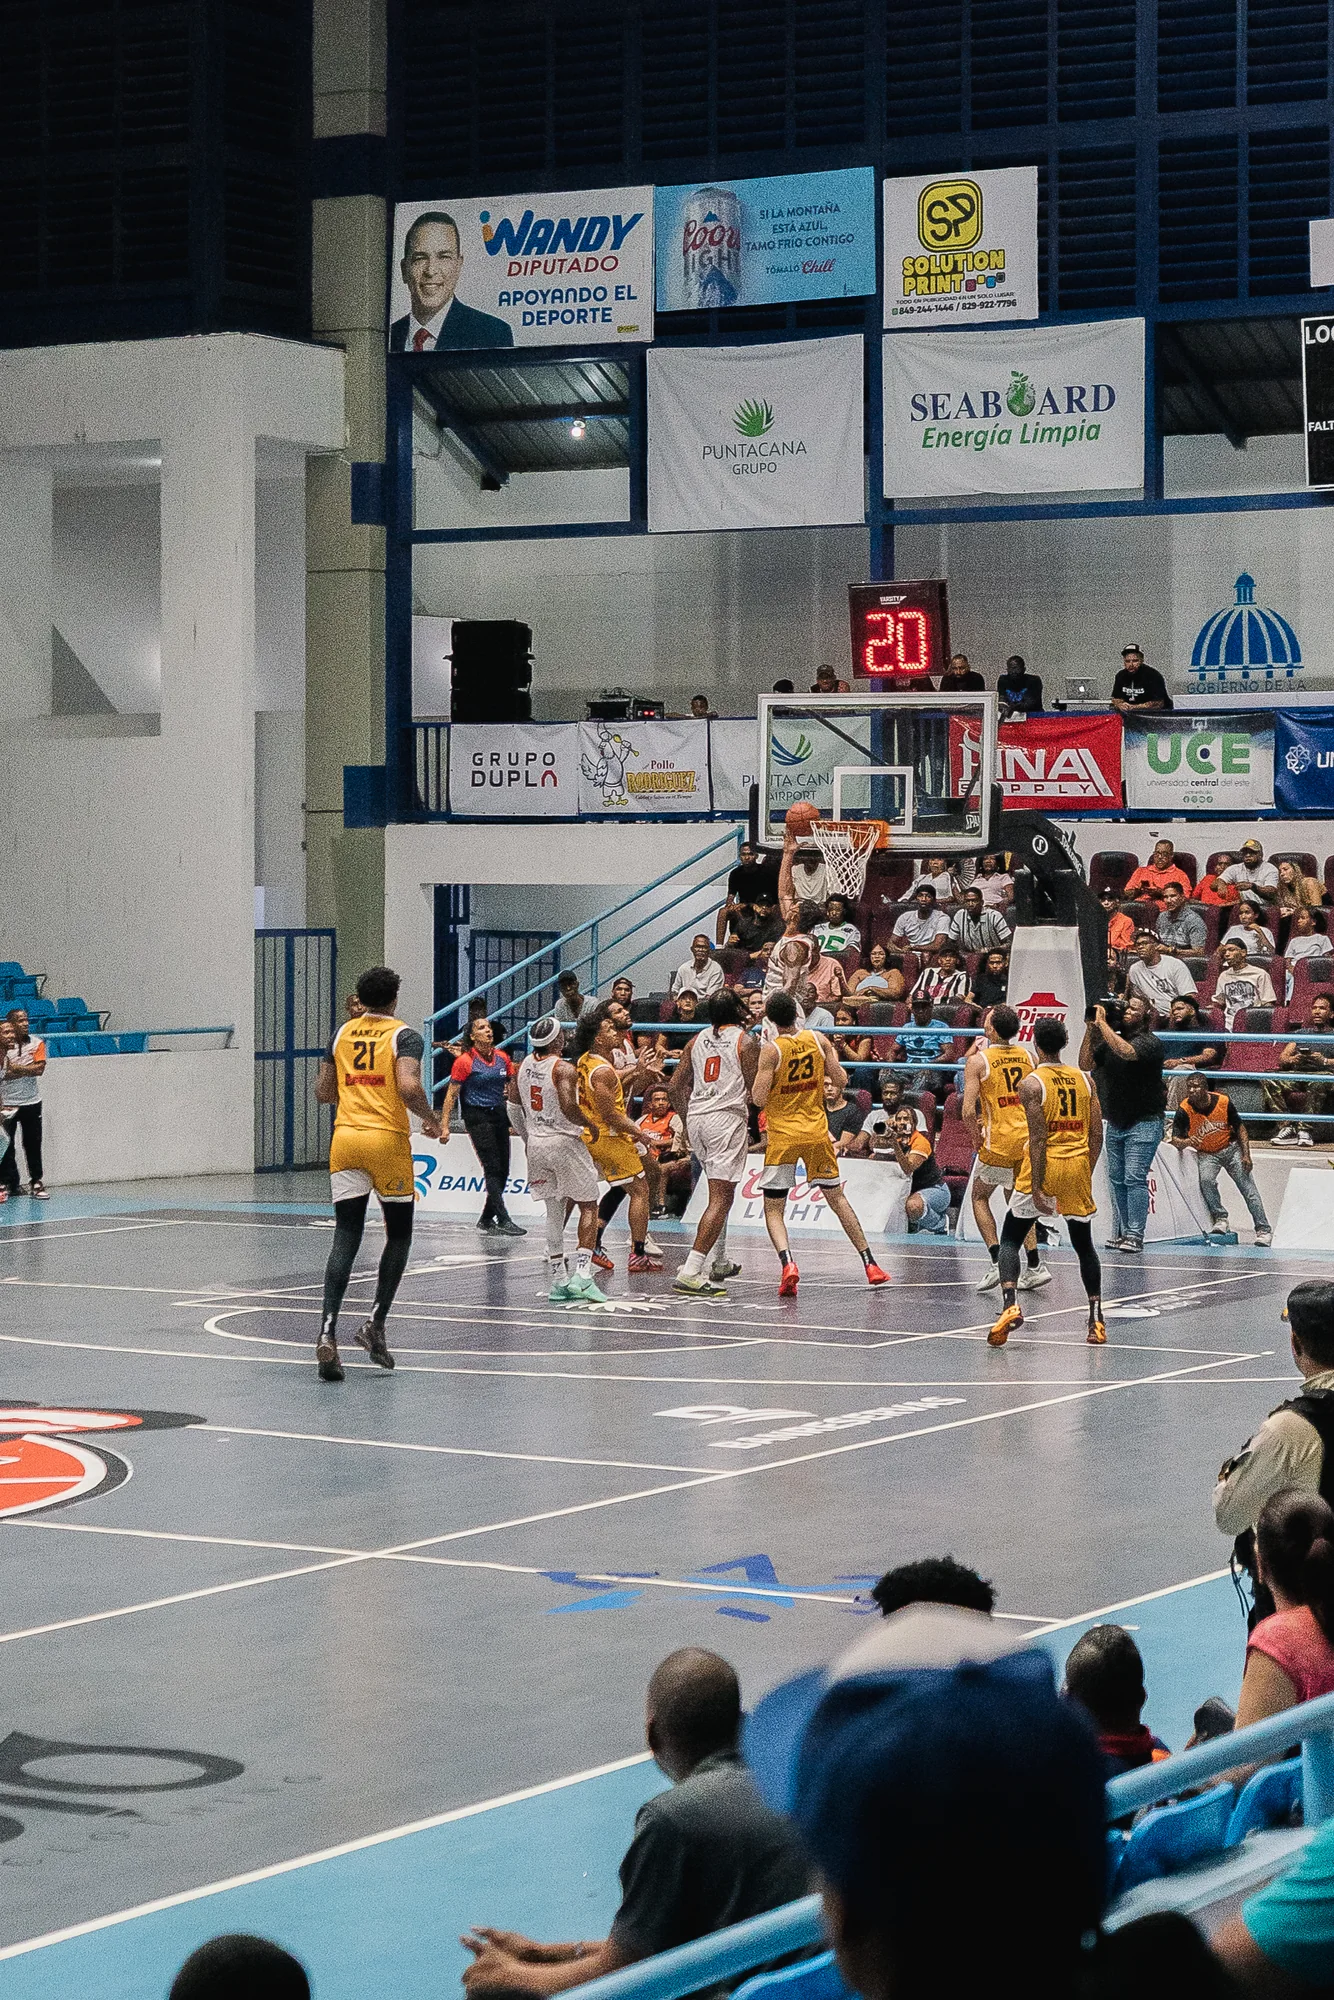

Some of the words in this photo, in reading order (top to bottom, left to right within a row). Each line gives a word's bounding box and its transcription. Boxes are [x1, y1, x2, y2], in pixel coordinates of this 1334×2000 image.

[760, 209, 768, 220] SI
[772, 208, 784, 219] LA
[787, 201, 841, 218] MONTAÑA
[773, 221, 796, 234] ESTÁ
[746, 241, 776, 251] TAMO
[805, 233, 855, 247] CONTIGO
[507, 255, 619, 277] DIPUTADO
[802, 259, 837, 274] Chill
[902, 249, 1006, 276] SOLUTION
[499, 287, 608, 306] APOYANDO
[614, 284, 638, 300] EL
[902, 273, 965, 297] PRINT
[522, 307, 613, 327] DEPORTE
[1305, 324, 1334, 345] LO
[921, 423, 1013, 451] Energía
[1019, 418, 1102, 448] Limpia
[702, 440, 807, 460] PUNTACANA
[732, 461, 778, 475] GRUPO
[866, 611, 928, 672] 20
[1187, 680, 1259, 694] GOBIERNO
[1264, 680, 1282, 692] DE
[1289, 680, 1307, 691] LA
[471, 751, 556, 767] GRUPO
[1146, 732, 1252, 775] UCE
[650, 760, 675, 770] Pollo
[960, 784, 1090, 794] SPPLY
[1146, 779, 1189, 787] universidad
[1190, 778, 1219, 787] central
[353, 1040, 376, 1070] 21
[703, 1055, 722, 1084] 0
[788, 1053, 814, 1082] 23
[1002, 1066, 1023, 1092] 12
[530, 1085, 544, 1112] 5
[1058, 1088, 1077, 1117] 31
